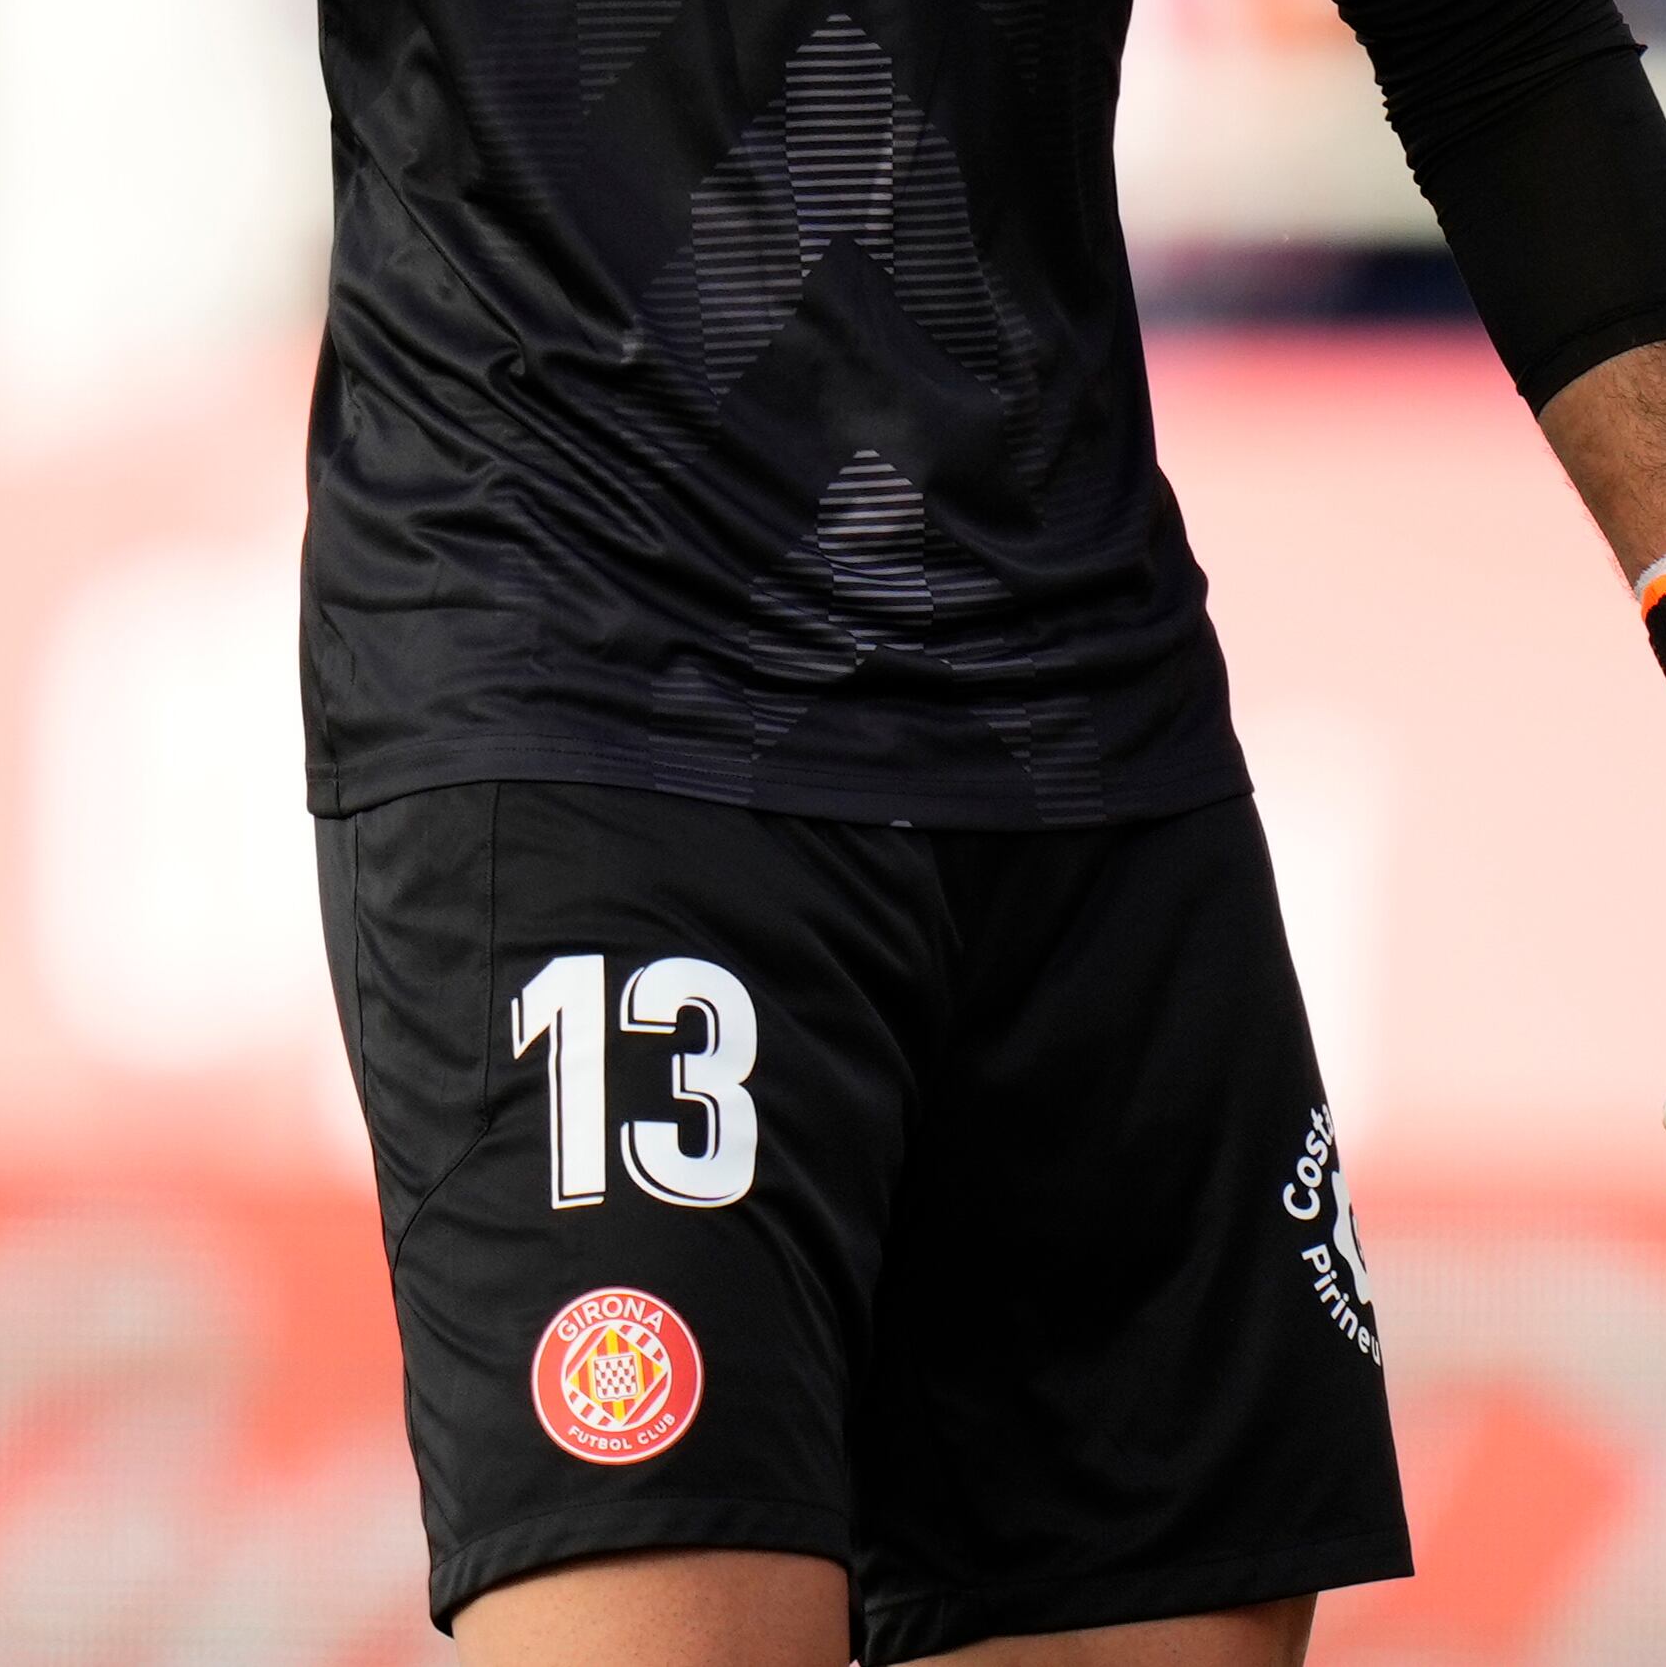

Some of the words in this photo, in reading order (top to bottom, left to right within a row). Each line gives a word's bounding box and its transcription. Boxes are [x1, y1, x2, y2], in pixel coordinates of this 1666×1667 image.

[511, 954, 758, 1210] 13
[556, 1296, 665, 1342] GIRONA
[568, 1426, 632, 1451] FUTBOL
[637, 1413, 676, 1445] CLUB
